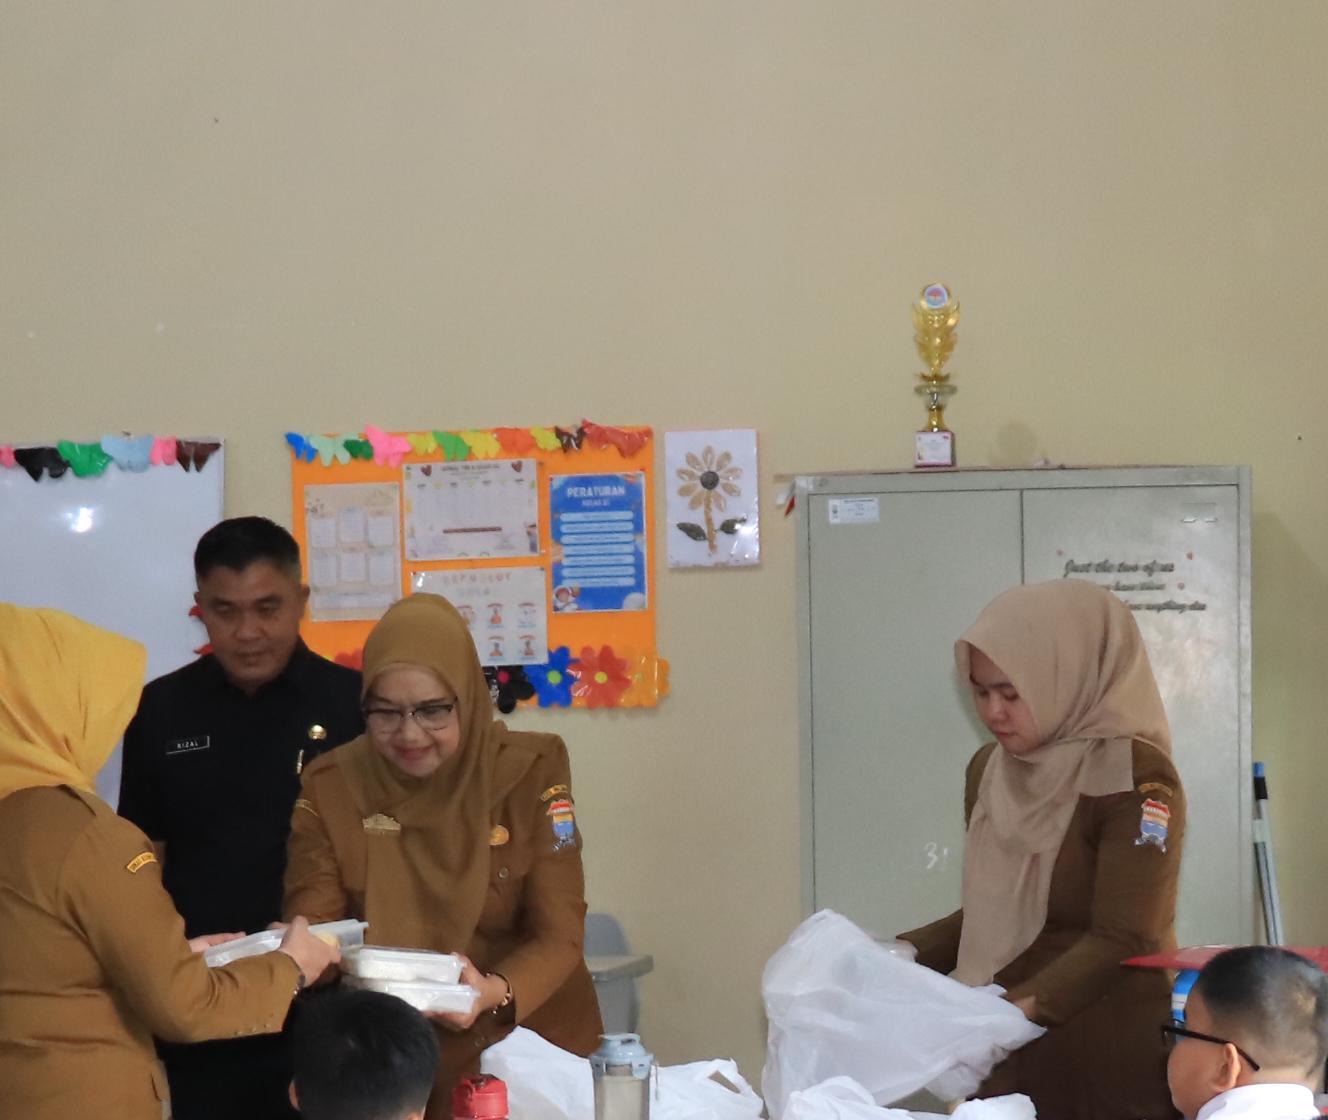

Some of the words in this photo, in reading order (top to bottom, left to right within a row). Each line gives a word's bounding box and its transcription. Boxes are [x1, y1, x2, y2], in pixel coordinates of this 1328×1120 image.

[567, 486, 626, 498] PERATURAN
[1063, 559, 1092, 578] Just
[1095, 559, 1114, 573] the
[1117, 561, 1139, 573] two
[1142, 560, 1157, 577] of
